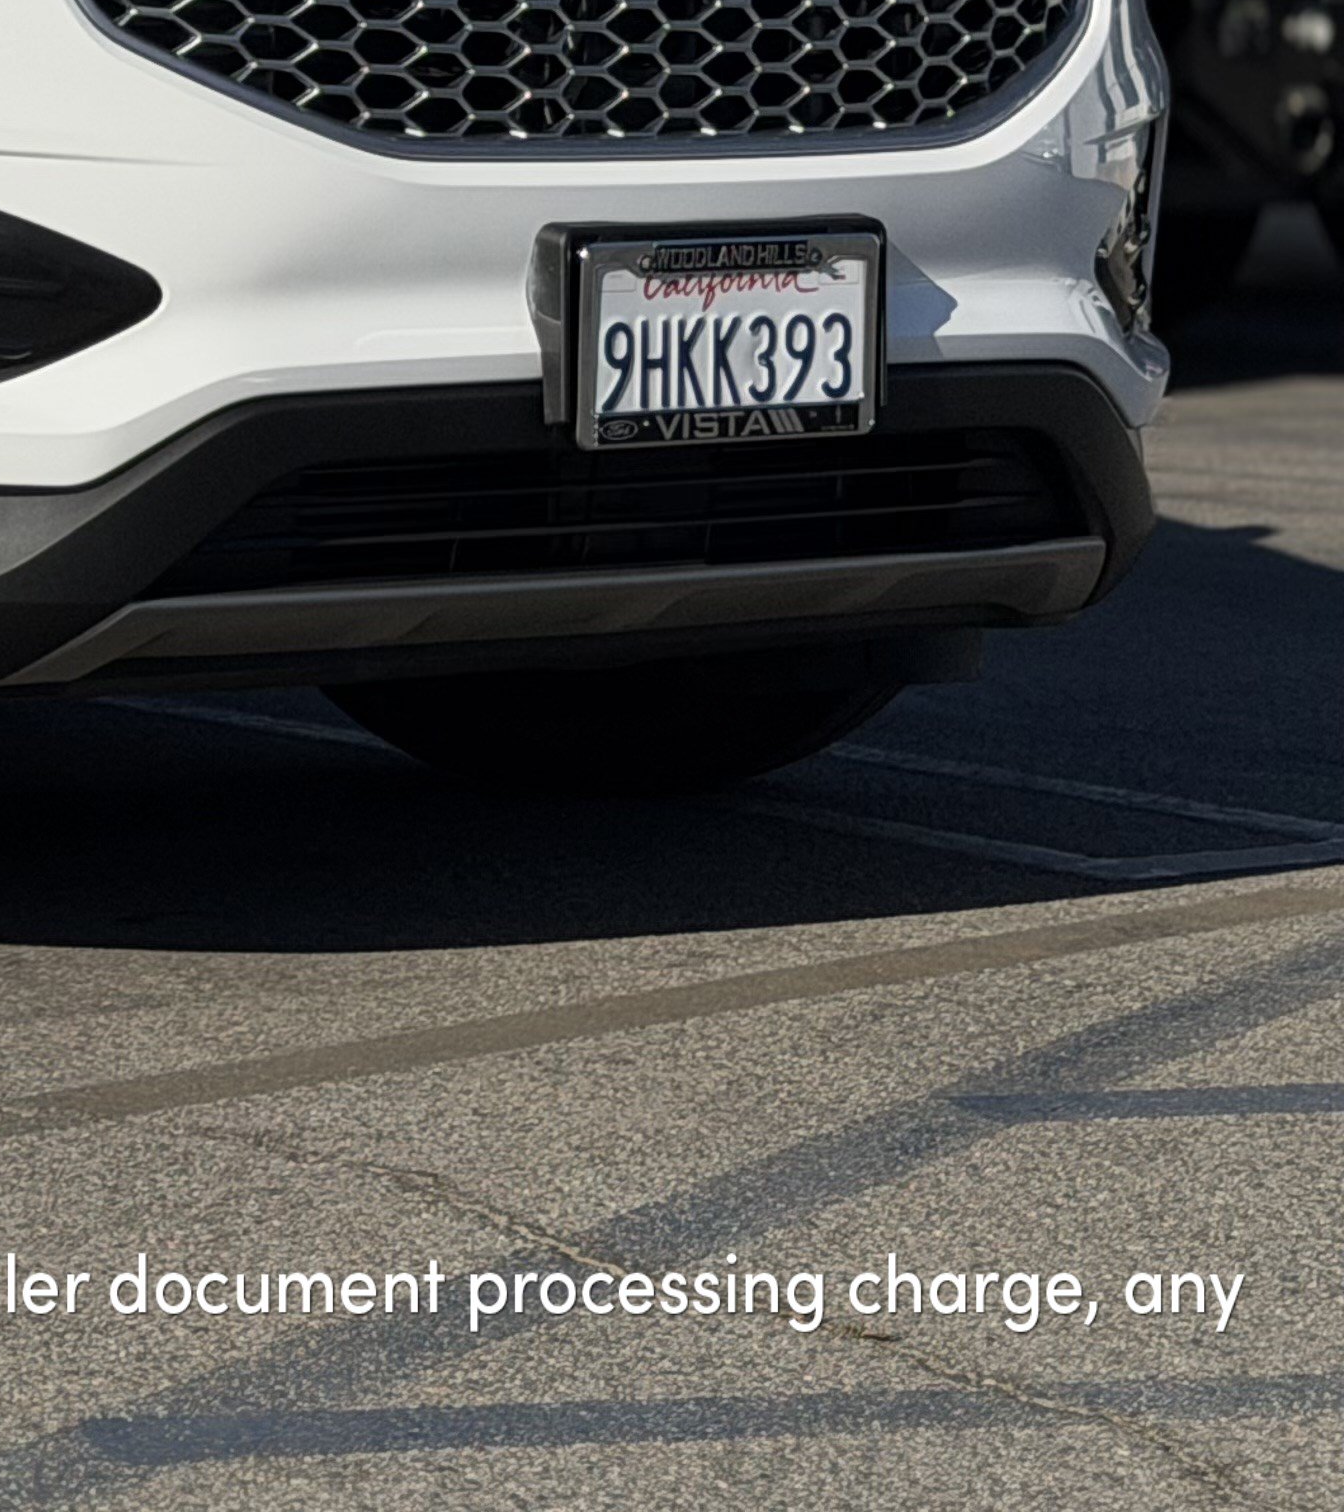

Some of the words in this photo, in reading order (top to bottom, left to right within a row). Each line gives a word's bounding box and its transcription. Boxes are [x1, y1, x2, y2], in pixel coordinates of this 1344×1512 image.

[655, 245, 754, 270] WOODLAND
[758, 244, 806, 266] HILLS
[643, 270, 820, 312] California
[602, 312, 853, 412] 9HKK393
[655, 409, 771, 440] VISTA
